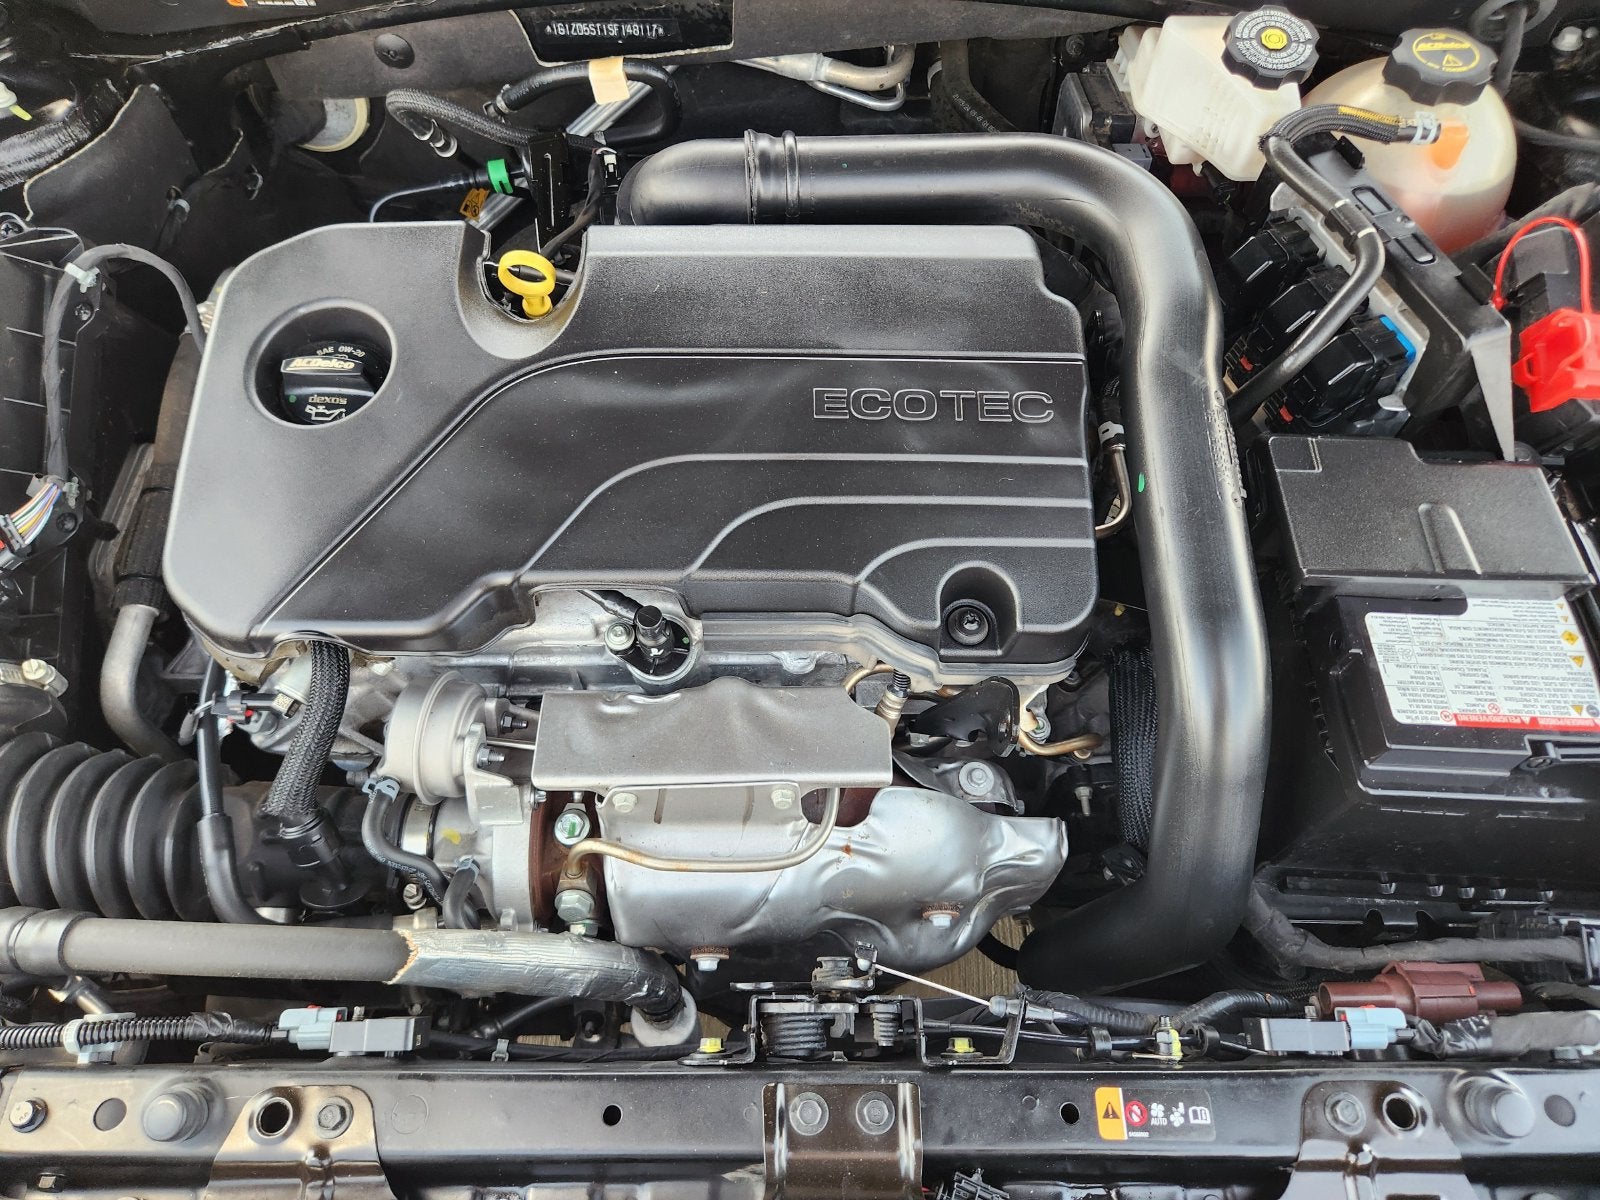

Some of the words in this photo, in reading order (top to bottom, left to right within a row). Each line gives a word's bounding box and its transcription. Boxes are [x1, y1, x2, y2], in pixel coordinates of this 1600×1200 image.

[316, 346, 334, 356] SAE
[338, 345, 366, 357] 0W-20
[286, 358, 355, 370] ACDelco
[308, 394, 348, 405] dexos
[812, 387, 1055, 424] ECOTEC
[1150, 1118, 1168, 1126] AUTO
